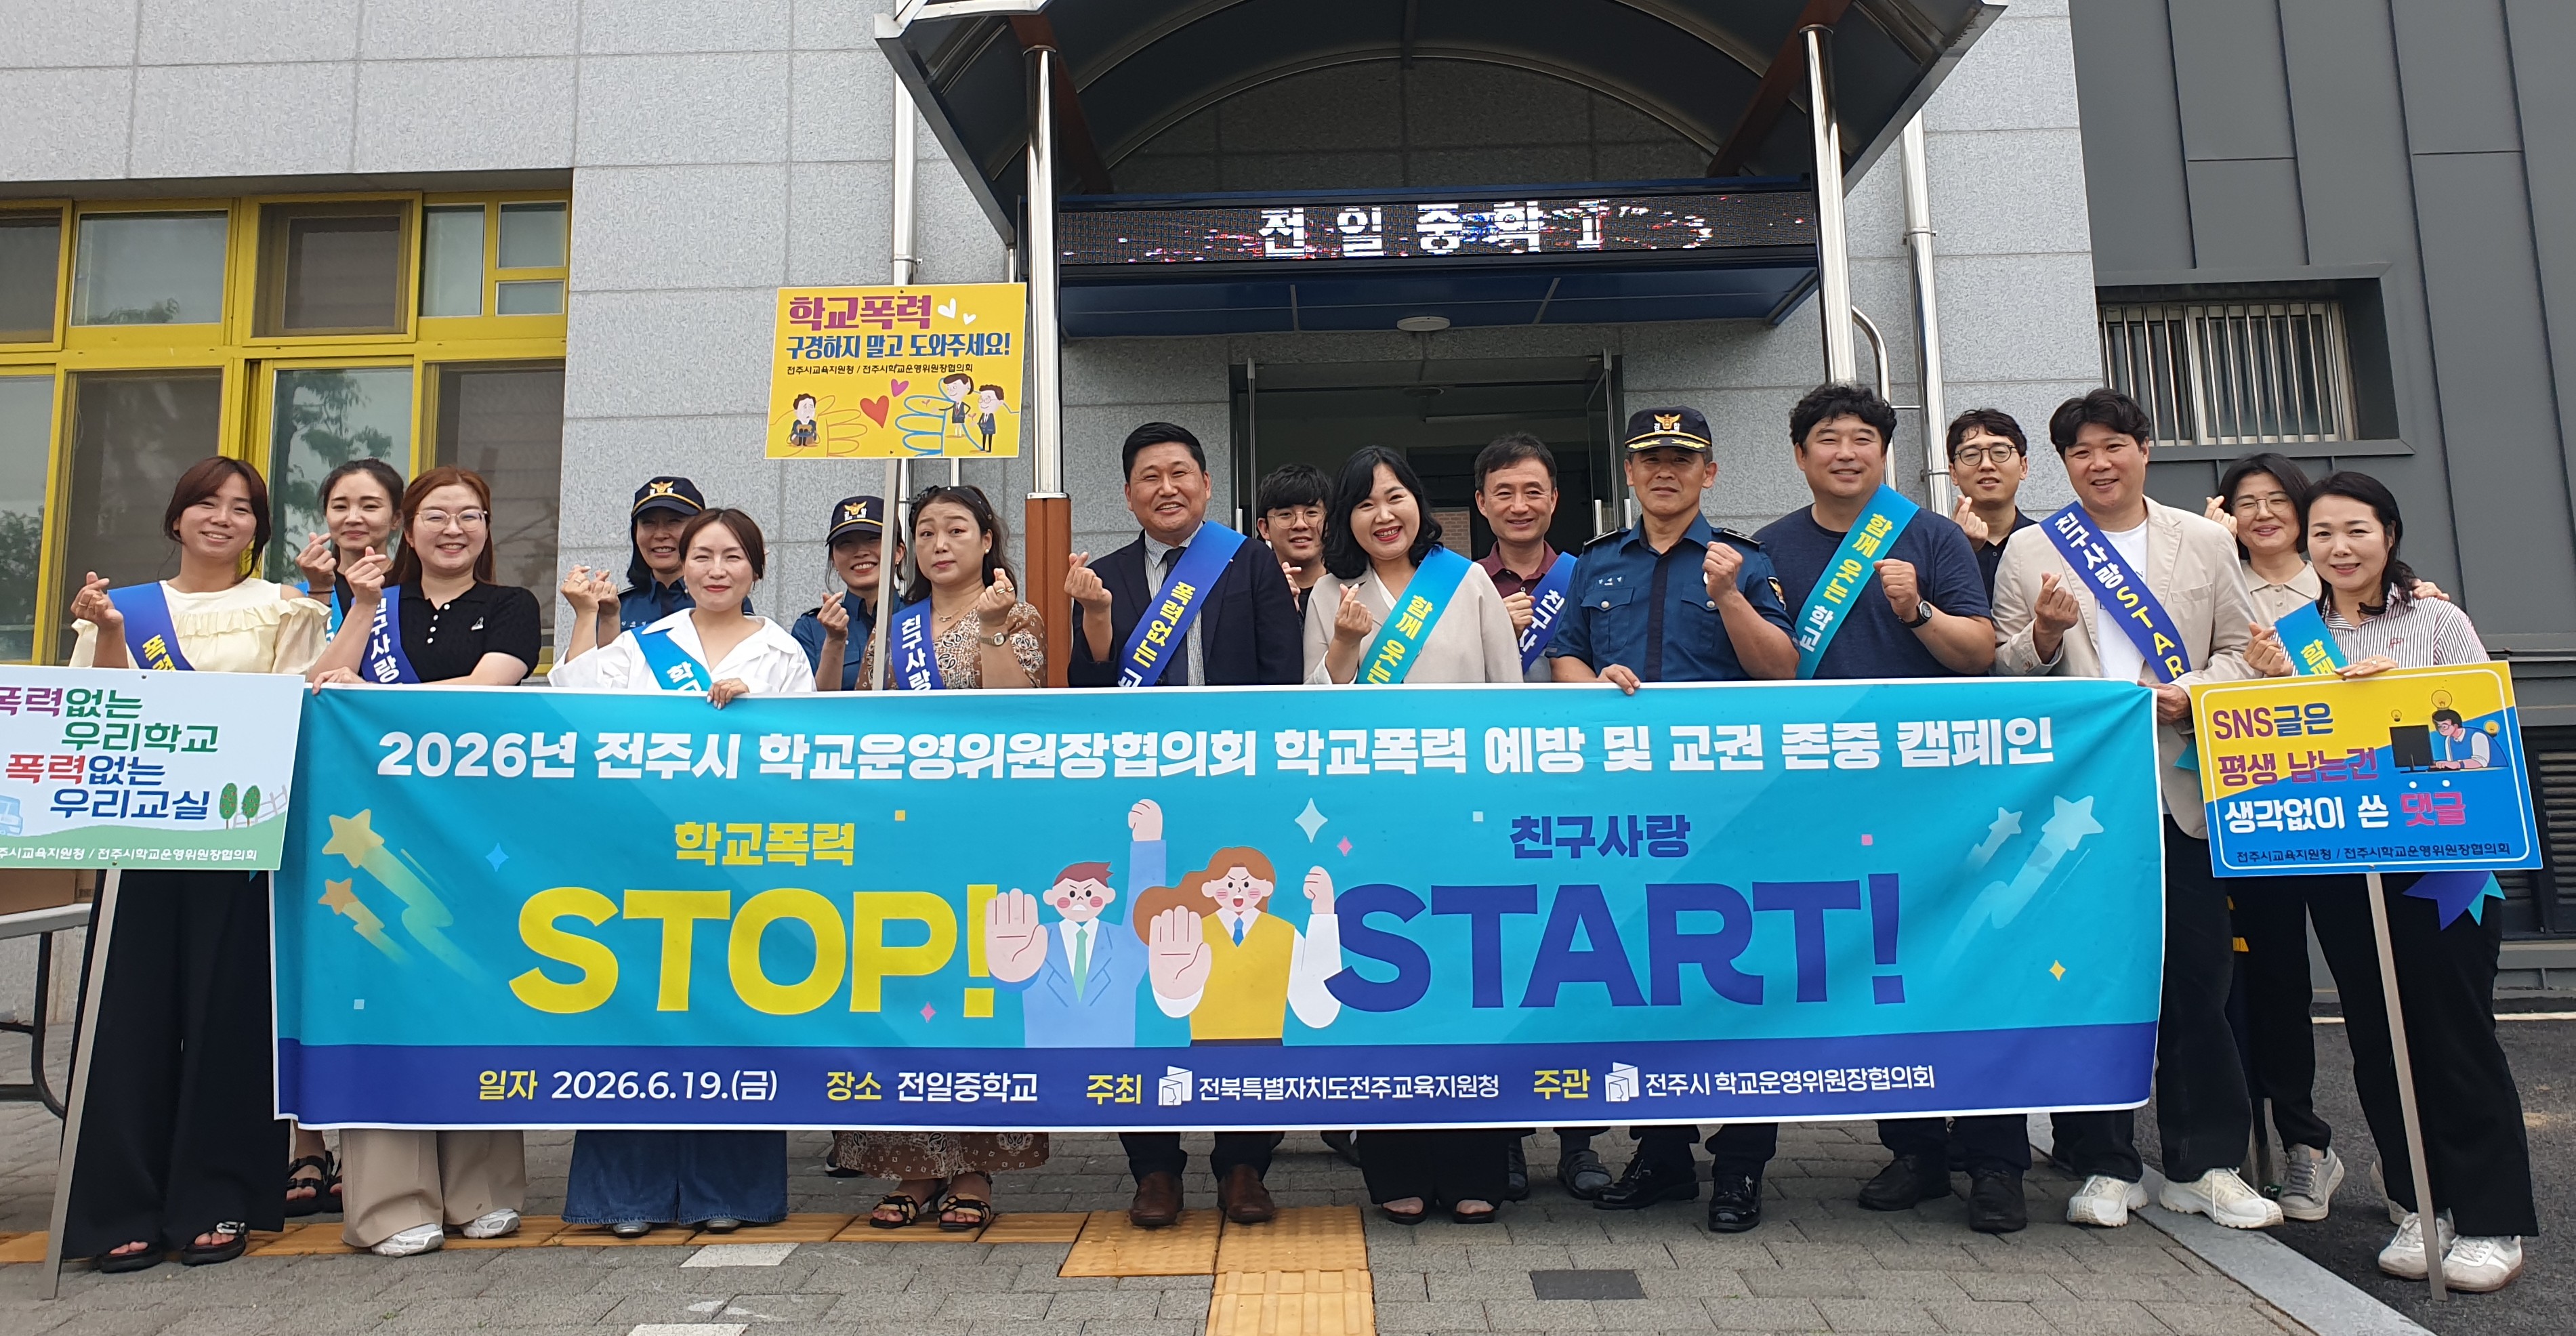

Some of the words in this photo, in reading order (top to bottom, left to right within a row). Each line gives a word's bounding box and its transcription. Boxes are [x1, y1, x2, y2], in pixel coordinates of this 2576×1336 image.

[789, 295, 932, 331] 학교폭력
[786, 336, 860, 359] 구경하지
[867, 335, 903, 358] 말고
[909, 332, 1010, 358] 도와주세요!
[787, 365, 854, 375] 전주시교육지원청
[863, 364, 973, 374] 전주시학교운영위원장협의회
[1852, 513, 1893, 558] 함께
[1823, 559, 1863, 604] 웃는
[1133, 581, 1196, 668] 폭력없는
[1395, 595, 1433, 640] 함께
[1519, 589, 1565, 662] 친구사
[1799, 605, 1834, 652] 학교
[902, 614, 932, 690] 친구사랑
[1367, 640, 1406, 684] 웃는
[61, 722, 219, 753] 우리학교
[2212, 703, 2333, 740] SNS글은
[5, 754, 165, 785] 폭력없는
[377, 730, 577, 778] 2026년
[594, 731, 742, 780] 전주시
[758, 729, 1255, 781] 학교운영위원장협의회
[1274, 726, 1467, 776] 학교폭력
[1484, 724, 1584, 773] 예방
[1603, 725, 1654, 772] 및
[1669, 723, 1764, 772] 교권
[1781, 722, 1881, 770] 존중
[1897, 717, 2054, 768] 캠페인
[2218, 753, 2279, 787] 평생
[2287, 747, 2379, 783] 남는건
[50, 789, 210, 820] 우리교실
[2224, 795, 2345, 833] 생각없이
[2357, 795, 2389, 828] 쓴
[2400, 791, 2466, 827] 댓글
[88, 848, 95, 859] /
[98, 848, 257, 861] 전주시학교운영위원장협의회
[675, 822, 855, 866] 학교폭력
[1509, 814, 1691, 859] 친구사랑
[2237, 848, 2331, 863] 전주시교육지원청
[2335, 848, 2340, 859] /
[2344, 842, 2511, 860] 전주시학교운영위원장협의회
[509, 884, 997, 1017] STOP!
[1324, 873, 1905, 1012] START!
[478, 1070, 537, 1100] 일자
[551, 1070, 778, 1102] 2026.6.19.(금)
[826, 1072, 881, 1102] 장소
[896, 1072, 1038, 1104] 전일중학교
[1086, 1073, 1142, 1105] 주최
[1199, 1075, 1499, 1100] 전북특별자치도전주교육지원청
[1533, 1069, 1590, 1099] 주관
[1645, 1072, 1711, 1097] 전주시
[1715, 1065, 1935, 1095] 학교운영위원장협의회
